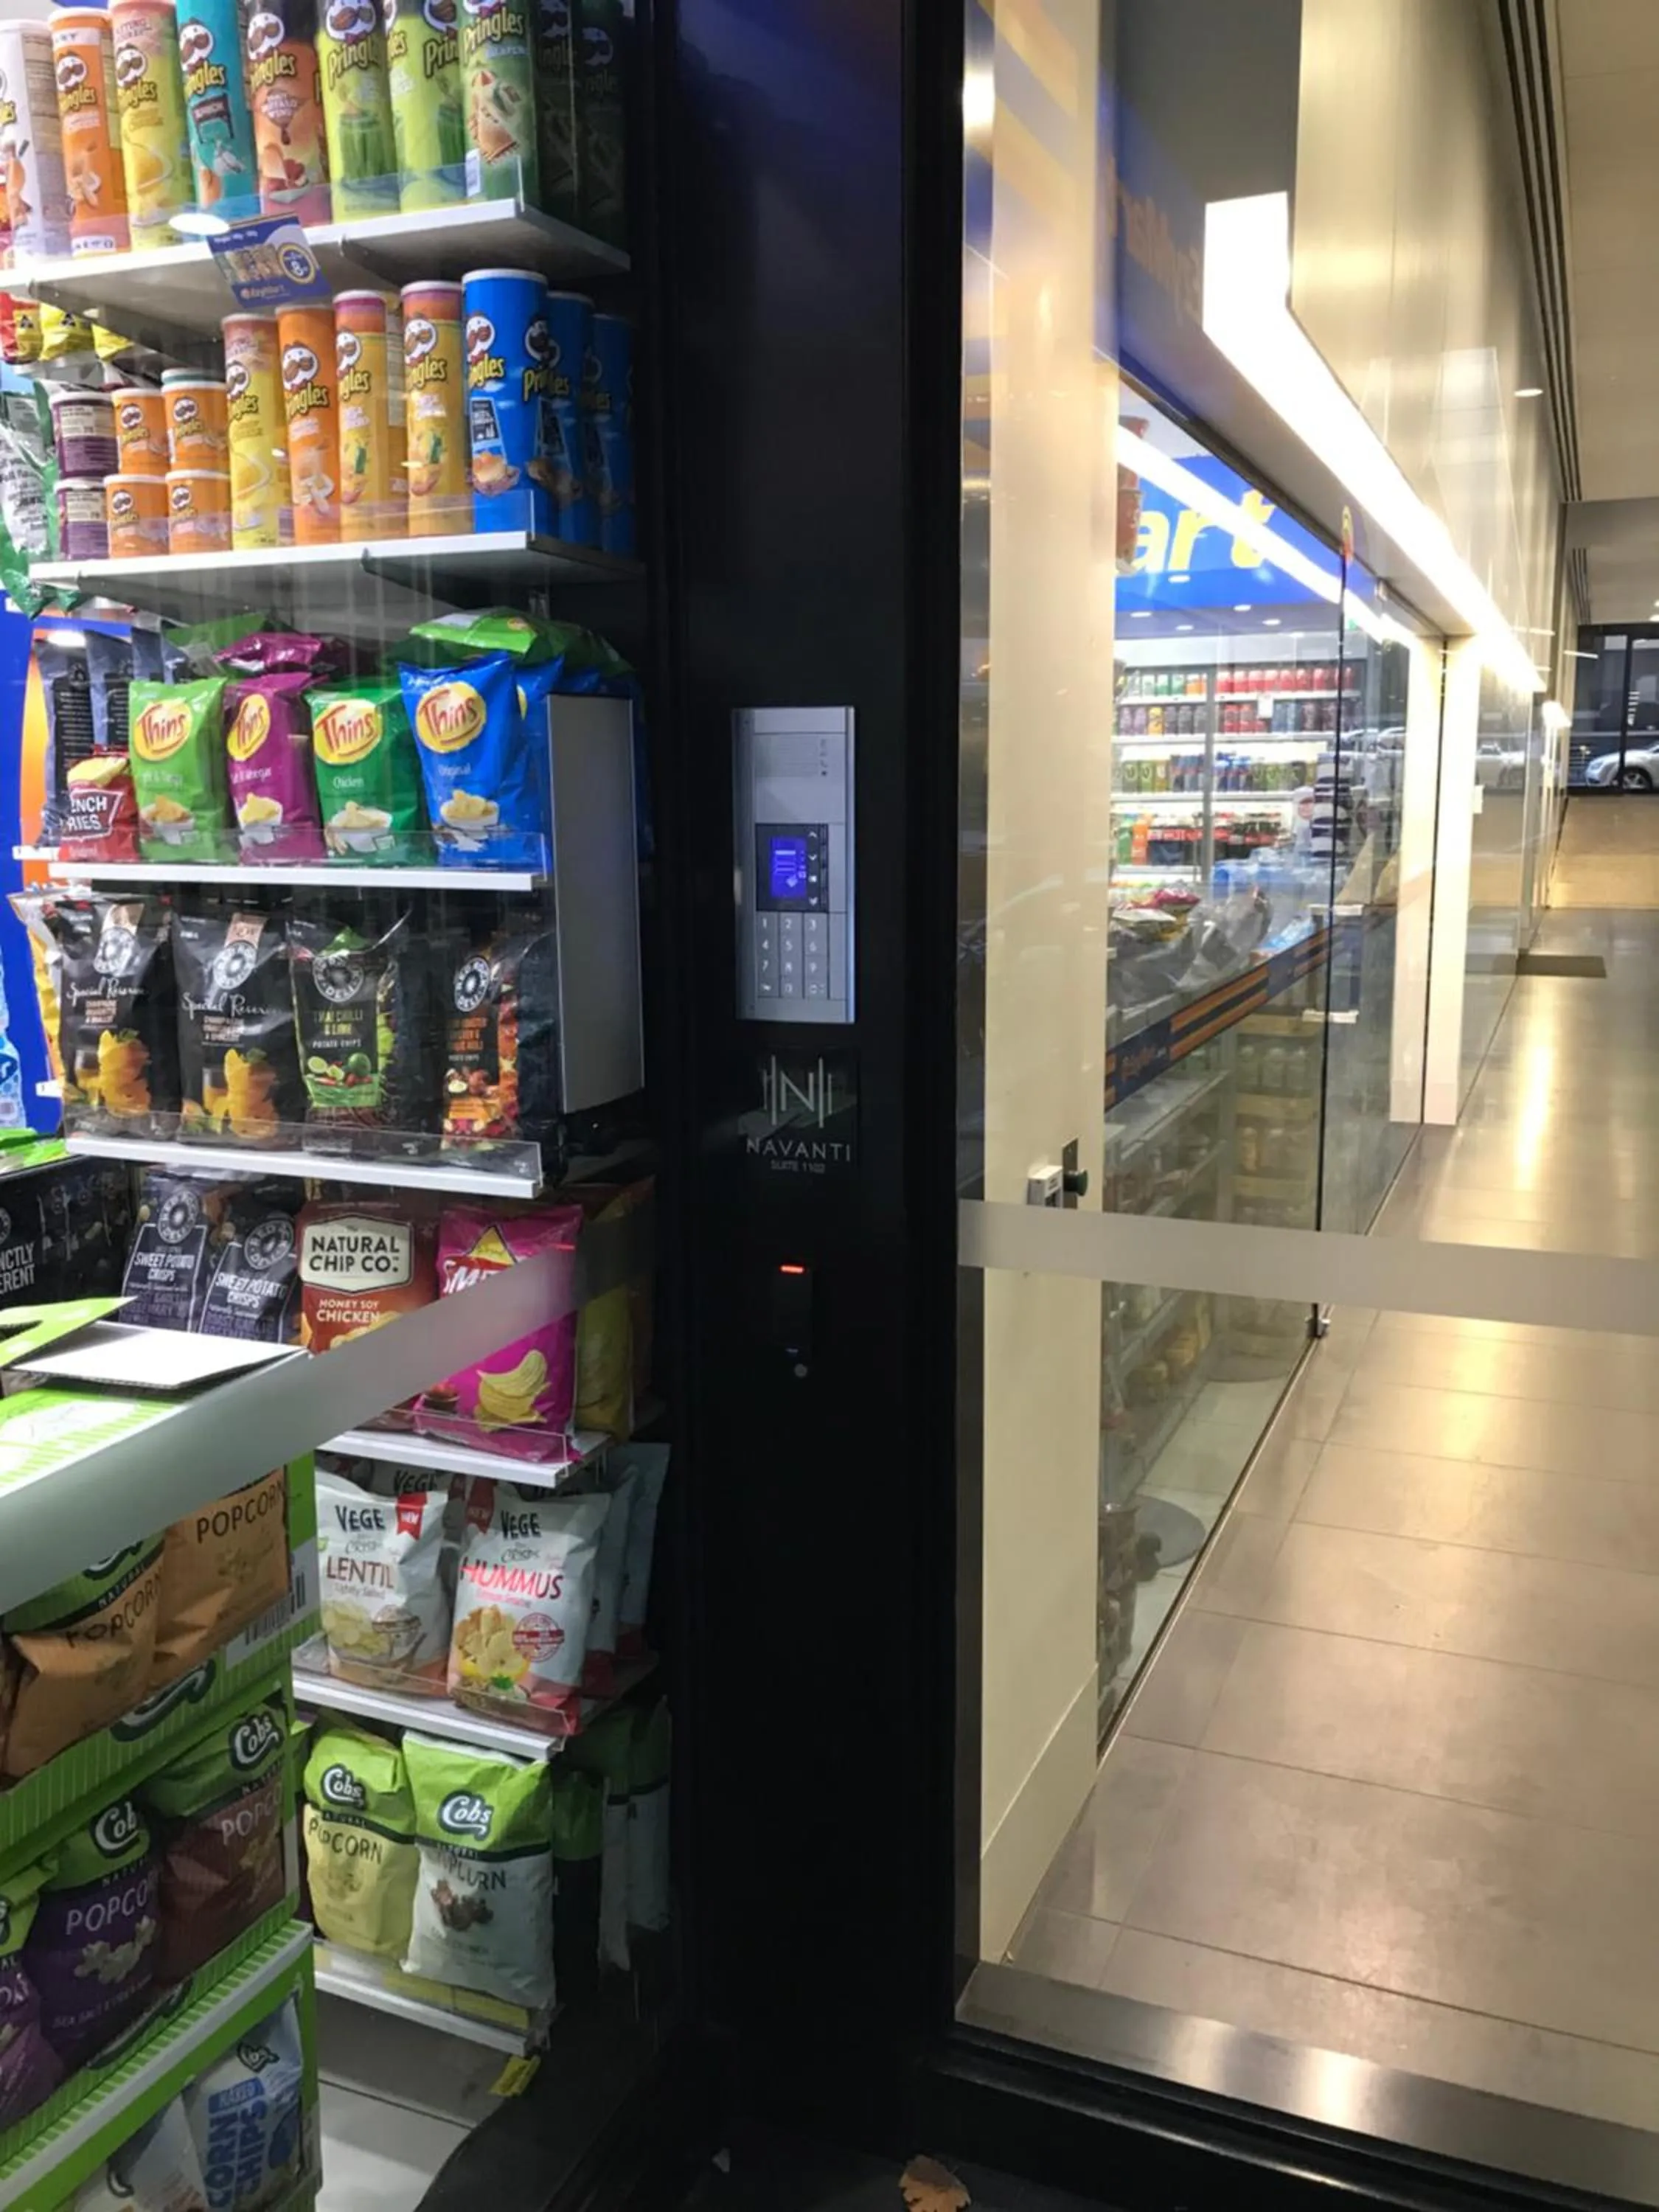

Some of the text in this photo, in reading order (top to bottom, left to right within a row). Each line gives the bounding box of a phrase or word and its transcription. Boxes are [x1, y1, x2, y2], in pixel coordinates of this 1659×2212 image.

[463, 7, 524, 66] Pringles
[137, 703, 186, 751] Thins
[315, 704, 375, 753] Thins
[420, 688, 478, 736] Thins
[333, 776, 365, 790] Chicken
[746, 1138, 851, 1163] NAVANTI
[310, 1235, 400, 1253] NATURAL
[309, 1255, 355, 1273] CHIP
[316, 1309, 381, 1324] CHICKEN
[319, 1298, 380, 1310] HONEY SOY
[334, 1504, 386, 1533] VEGE
[400, 1511, 420, 1526] NEW
[501, 1509, 542, 1540] VEGE
[326, 1556, 394, 1590] LENTIL
[459, 1556, 564, 1600] HUMMUS
[234, 1715, 279, 1764] Cobs
[324, 1767, 364, 1808] Cobs
[94, 1801, 140, 1850] Cob
[442, 1794, 493, 1836] Cobs
[65, 1879, 147, 1935] POPCO
